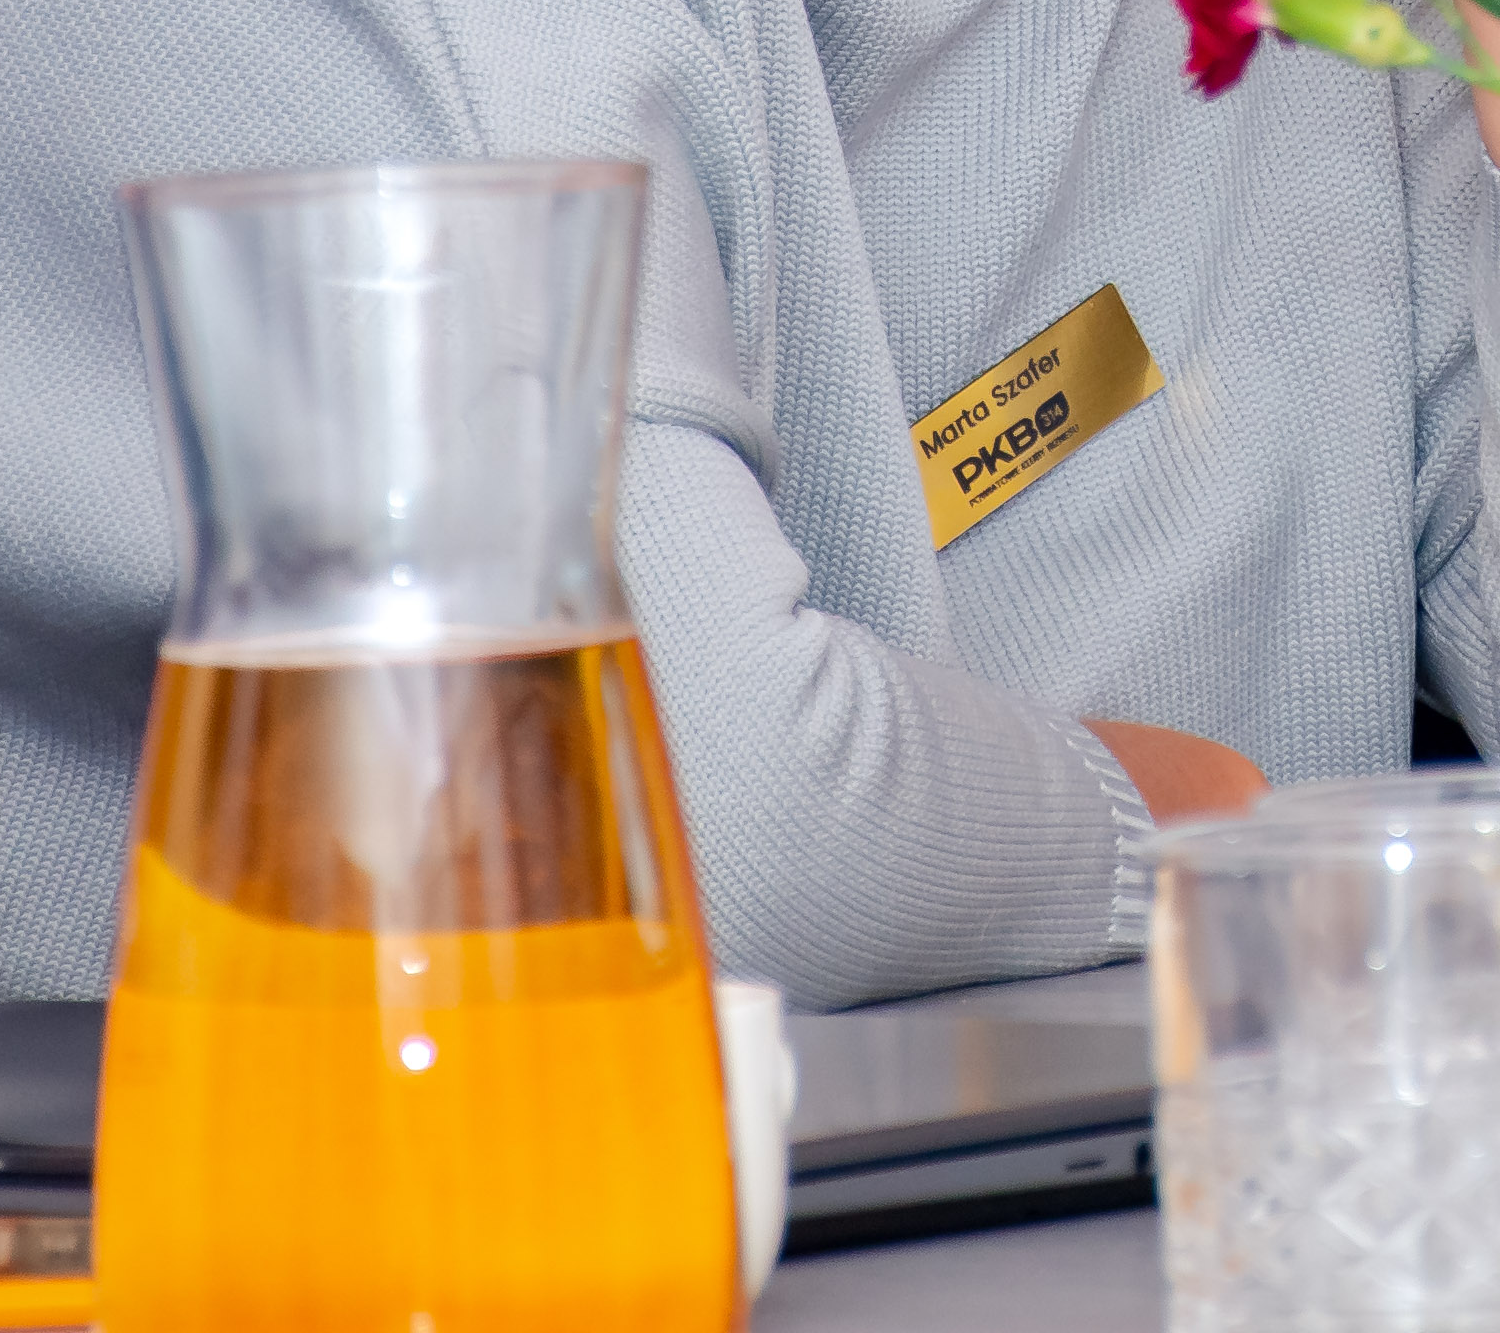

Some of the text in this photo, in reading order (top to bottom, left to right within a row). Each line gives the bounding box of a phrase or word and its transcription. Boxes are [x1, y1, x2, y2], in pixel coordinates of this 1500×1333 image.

[919, 347, 1061, 460] Marta Szafer
[952, 417, 1039, 495] PKB
